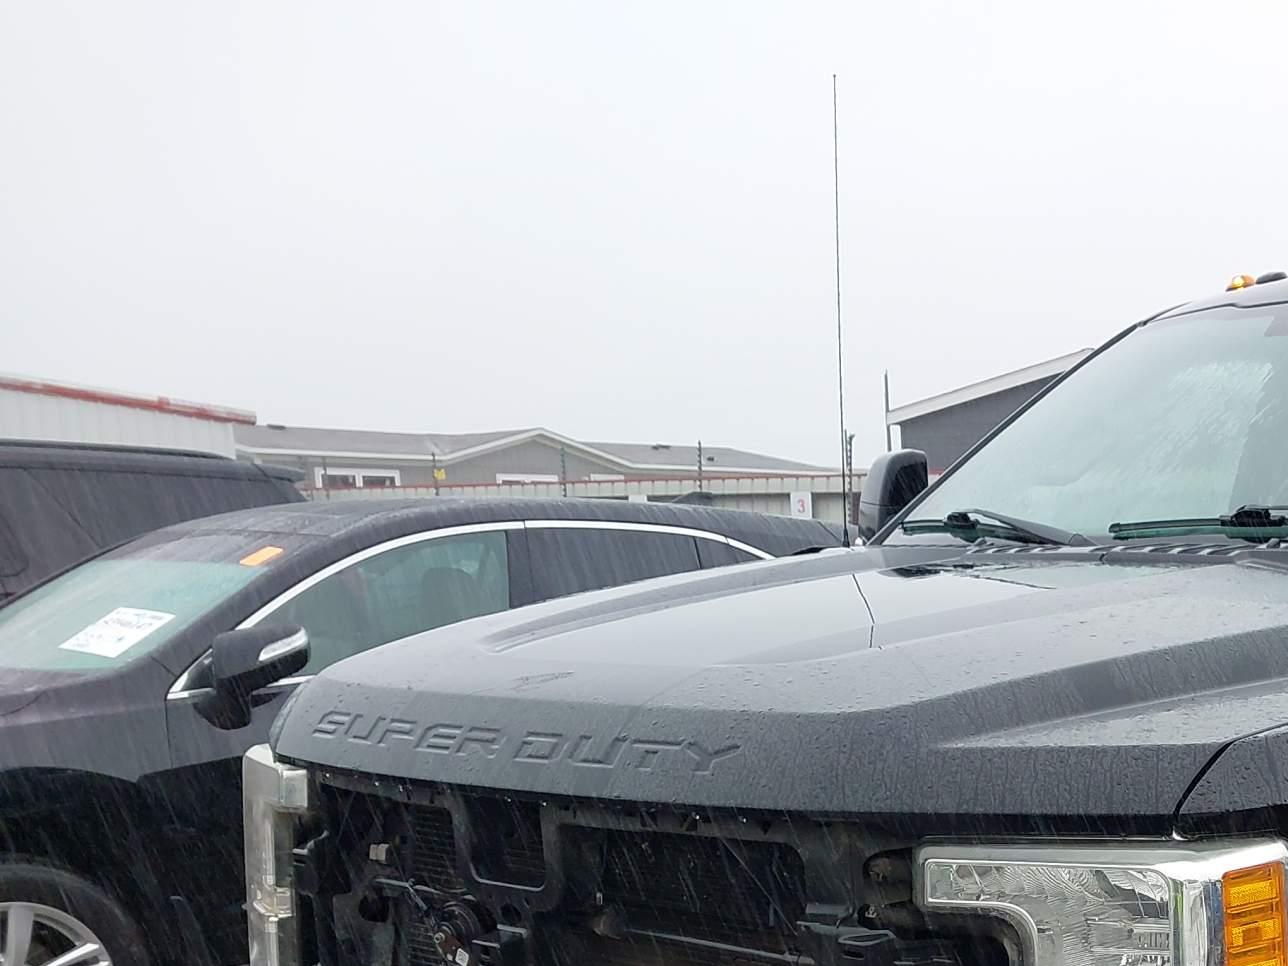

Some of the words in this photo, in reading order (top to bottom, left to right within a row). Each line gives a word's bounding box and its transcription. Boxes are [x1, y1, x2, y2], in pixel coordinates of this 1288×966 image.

[797, 498, 806, 513] 3
[312, 709, 502, 758] SUPER
[512, 730, 742, 775] DUTY
